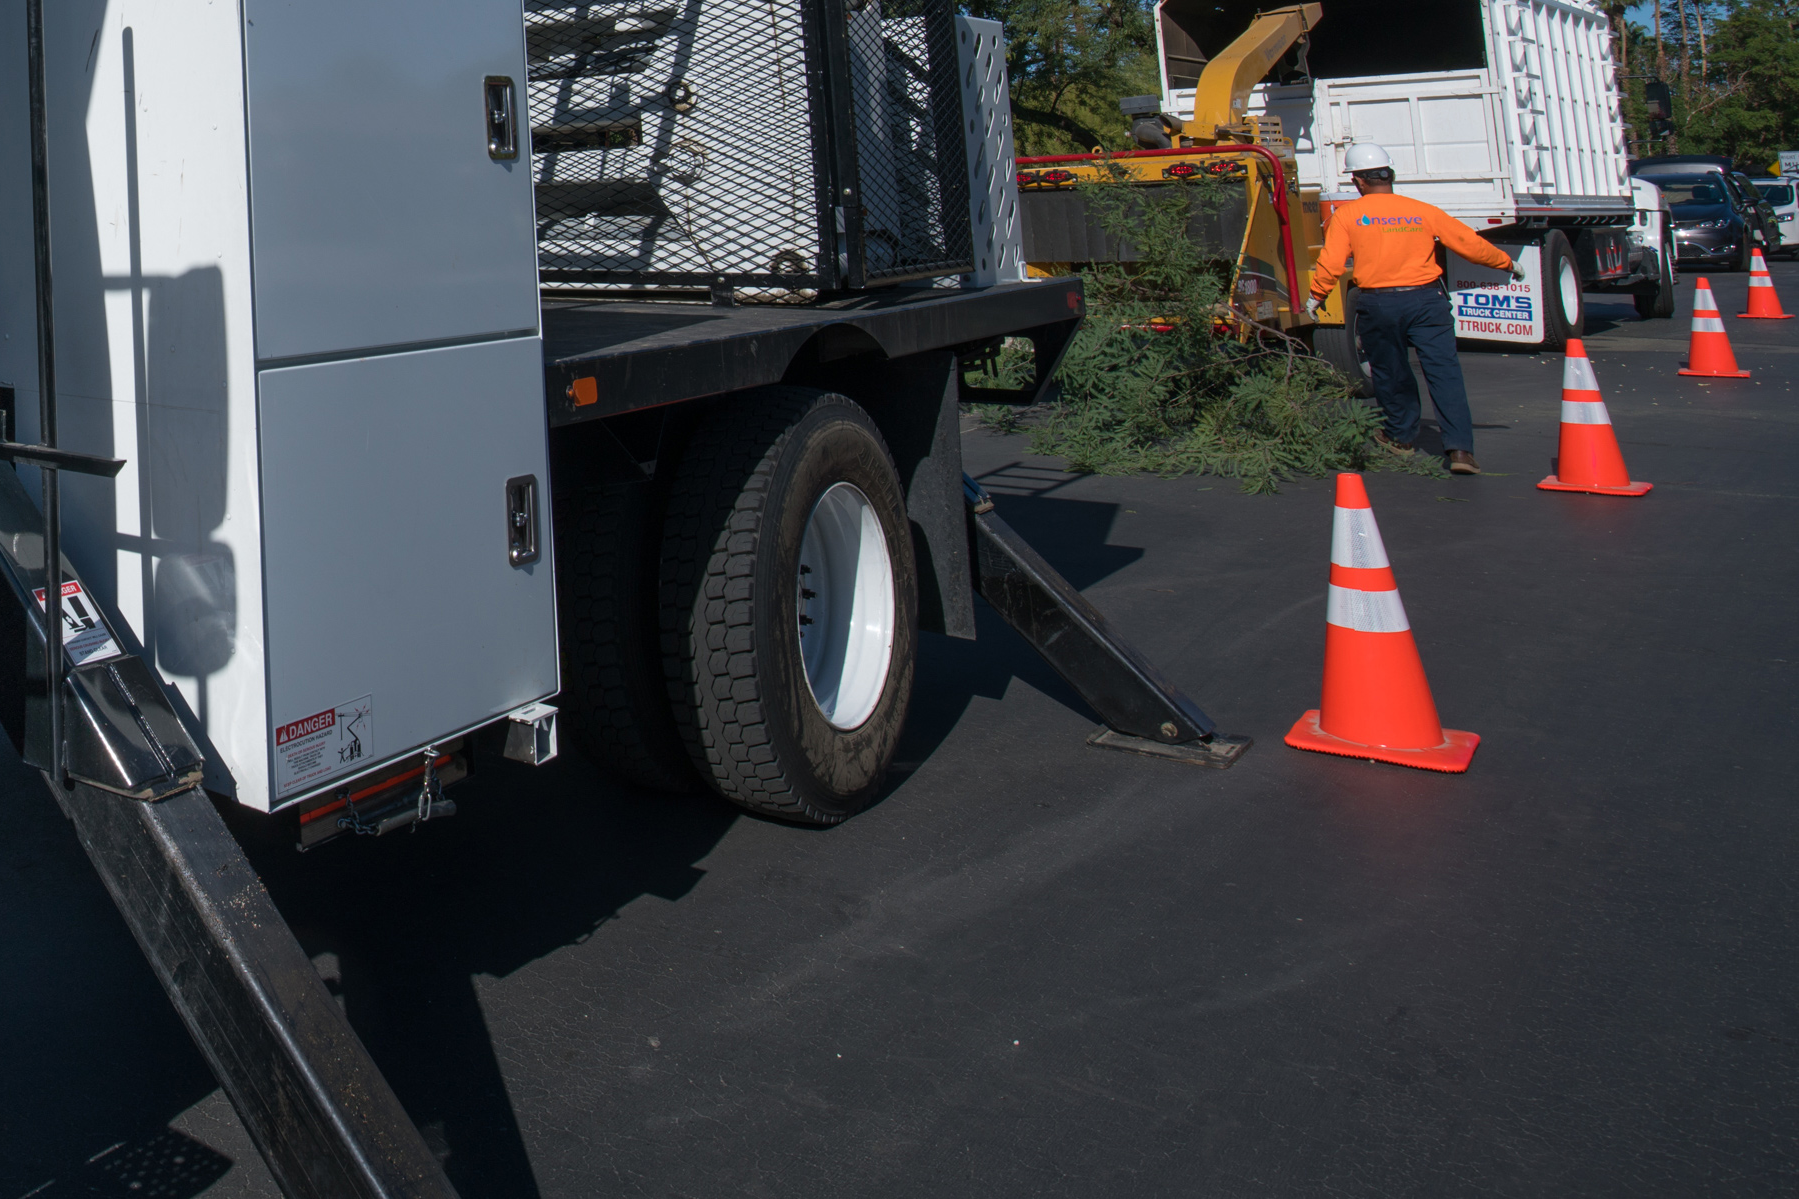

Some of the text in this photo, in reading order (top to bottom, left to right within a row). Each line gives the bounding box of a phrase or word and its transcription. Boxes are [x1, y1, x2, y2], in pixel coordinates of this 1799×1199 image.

[1457, 280, 1531, 293] 800-638-1015
[1457, 292, 1532, 309] TOM'S
[1462, 307, 1529, 320] TRUCK CENTER
[1458, 319, 1533, 336] TTRUCK.COM
[289, 713, 332, 740] DANGER
[280, 729, 333, 753] ELECTROCUTION HAZARD
